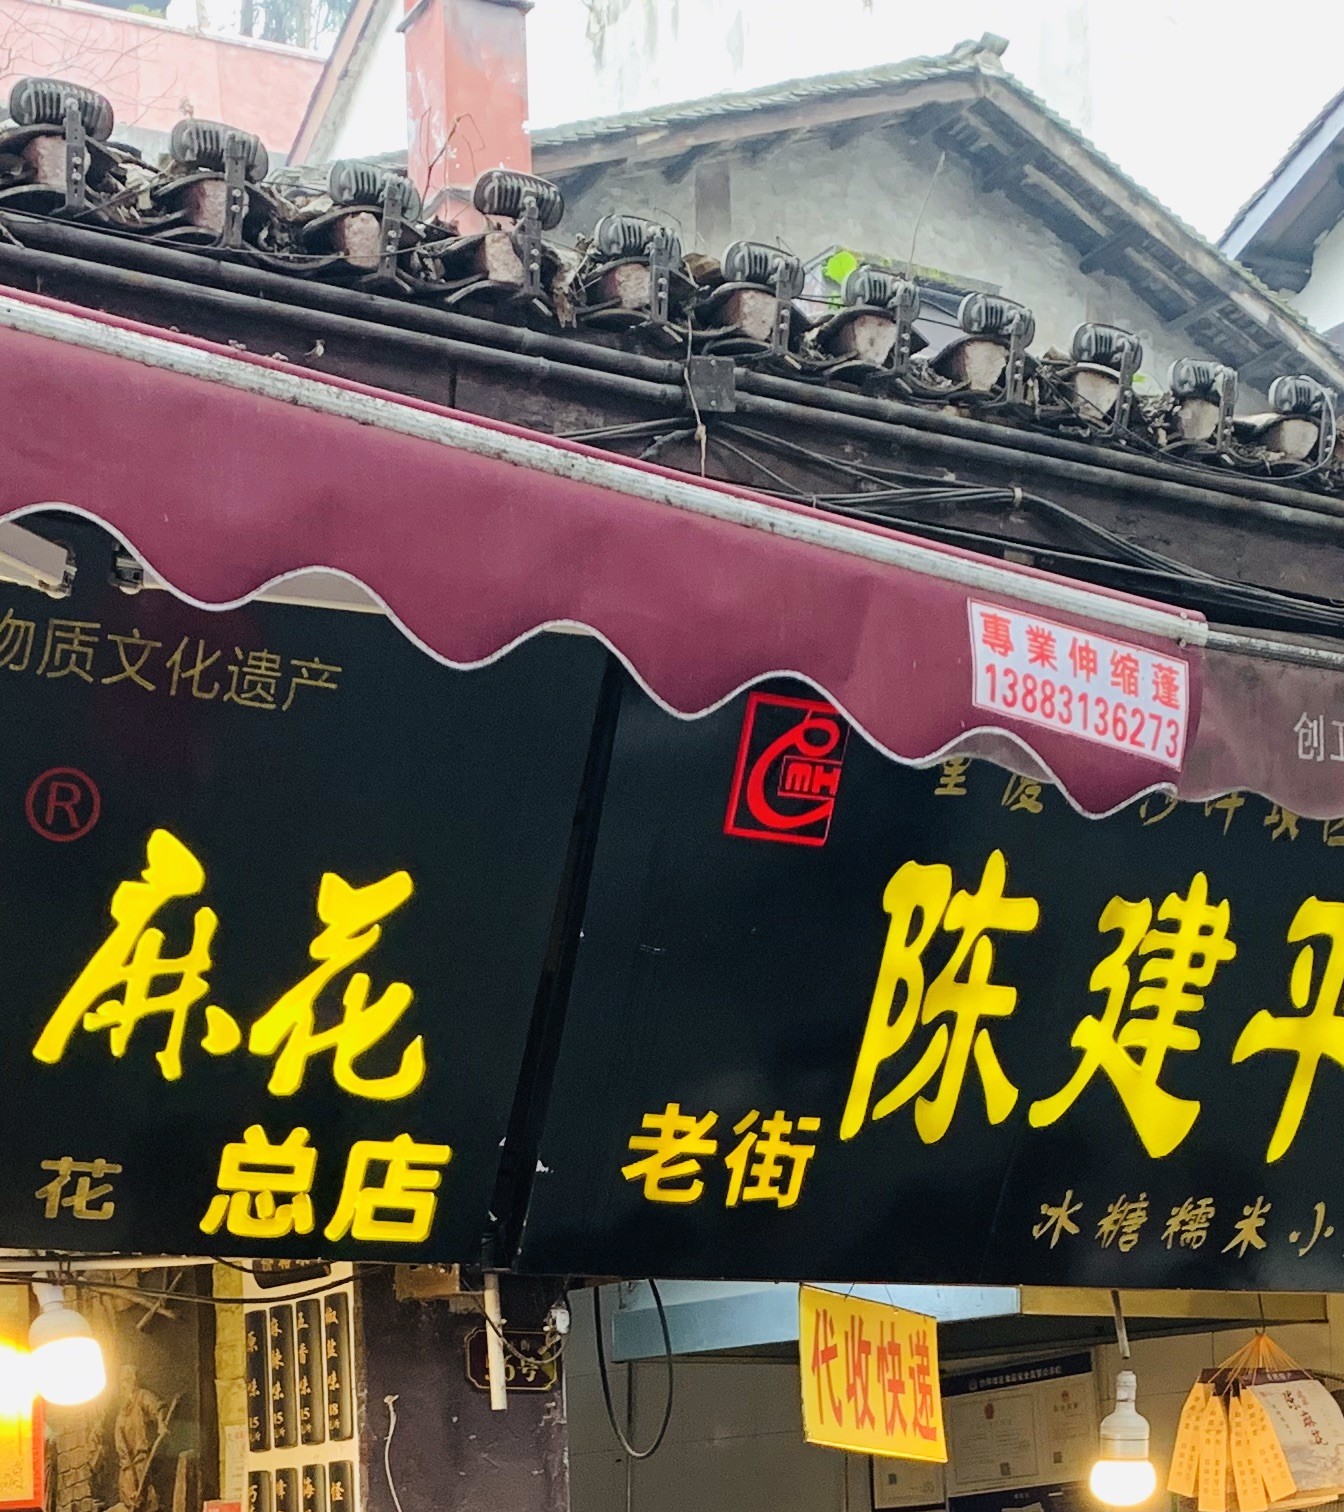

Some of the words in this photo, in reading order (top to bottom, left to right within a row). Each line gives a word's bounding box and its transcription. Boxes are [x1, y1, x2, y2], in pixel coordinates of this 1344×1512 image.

[985, 662, 1181, 759] 13883136273
[199, 1125, 452, 1243] 总店
[621, 1102, 821, 1208] 老街
[811, 1308, 938, 1443] 代收快递
